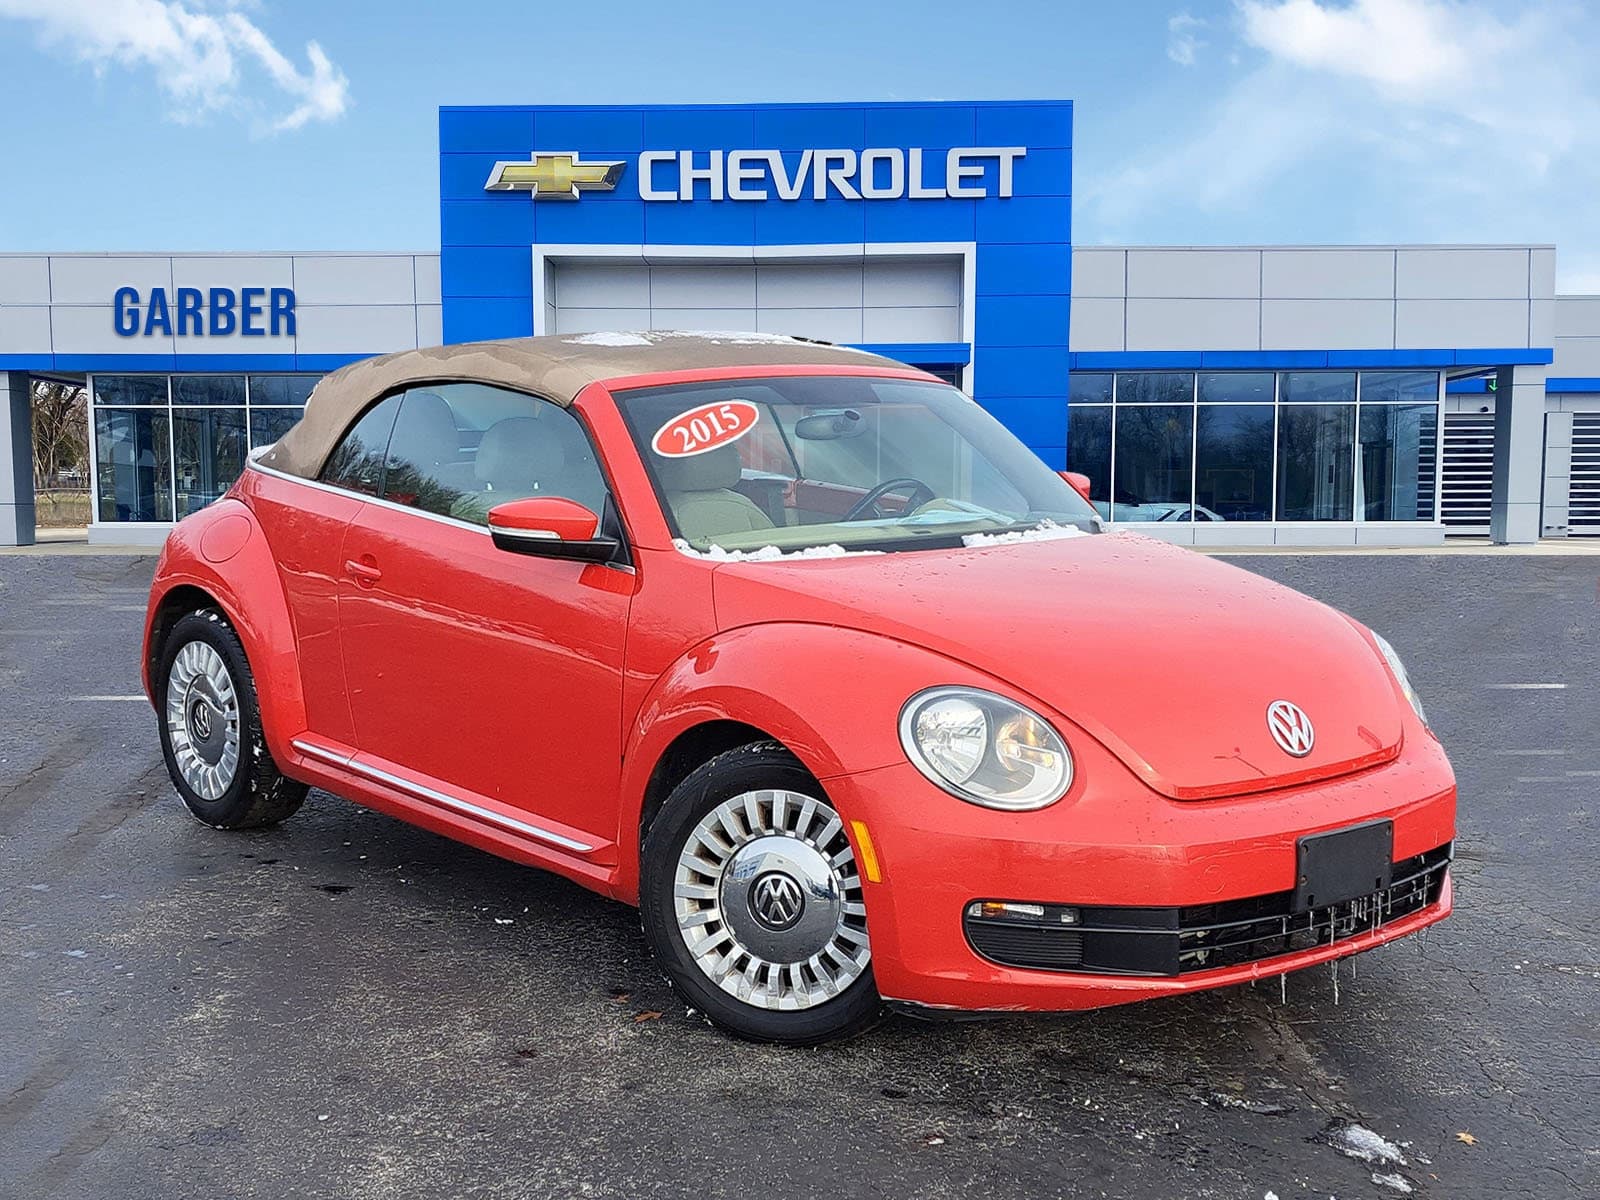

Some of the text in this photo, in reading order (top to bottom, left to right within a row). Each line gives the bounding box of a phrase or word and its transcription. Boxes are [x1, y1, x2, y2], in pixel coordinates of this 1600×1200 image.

[638, 146, 1027, 201] CHEVROLET
[113, 286, 297, 337] GARBER
[672, 404, 740, 453] 2015
